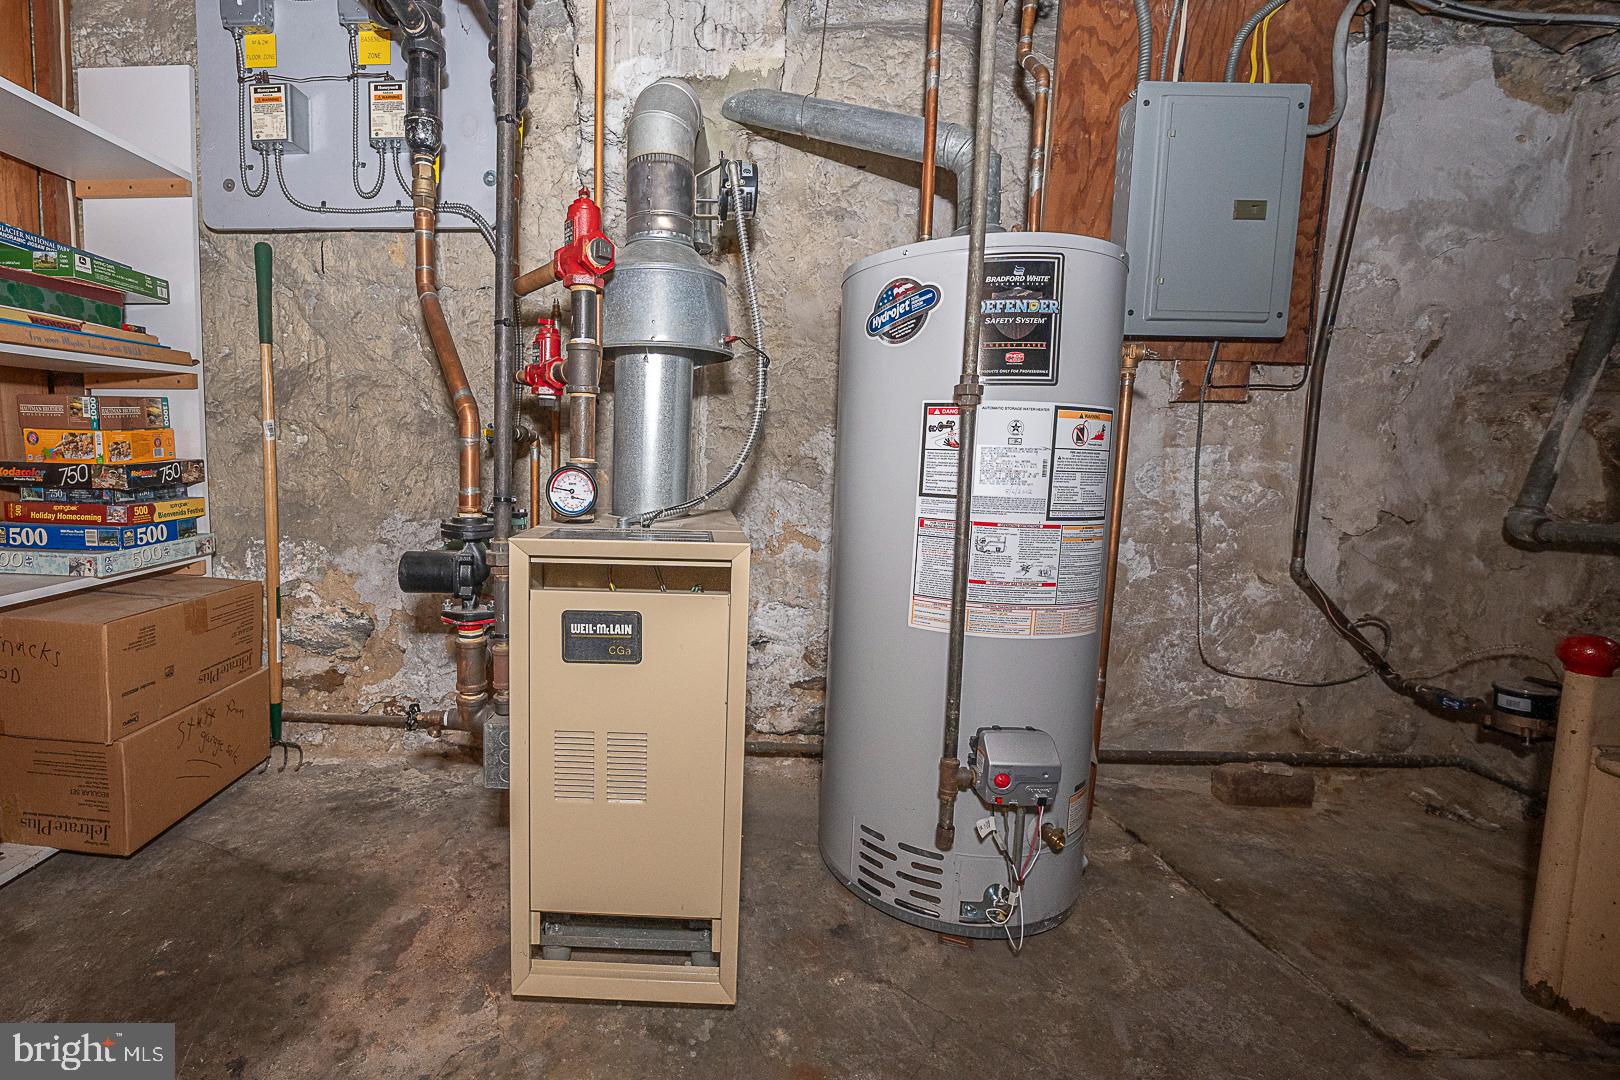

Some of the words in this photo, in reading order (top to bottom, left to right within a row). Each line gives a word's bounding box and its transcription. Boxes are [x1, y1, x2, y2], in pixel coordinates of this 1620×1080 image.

[25, 234, 56, 248] NATIONAL
[872, 300, 910, 328] Hydrojet
[58, 464, 88, 486] 750
[160, 462, 180, 484] 750
[30, 512, 56, 520] Holiday
[57, 512, 102, 522] Homecoming
[134, 506, 148, 516] 500
[158, 509, 186, 518] Bienvenida
[10, 528, 48, 546] 500
[136, 524, 168, 546] 500
[0, 636, 60, 667] nacks
[608, 646, 631, 655] CGa
[20, 818, 53, 836] Plus
[54, 820, 110, 842] Jeltrate
